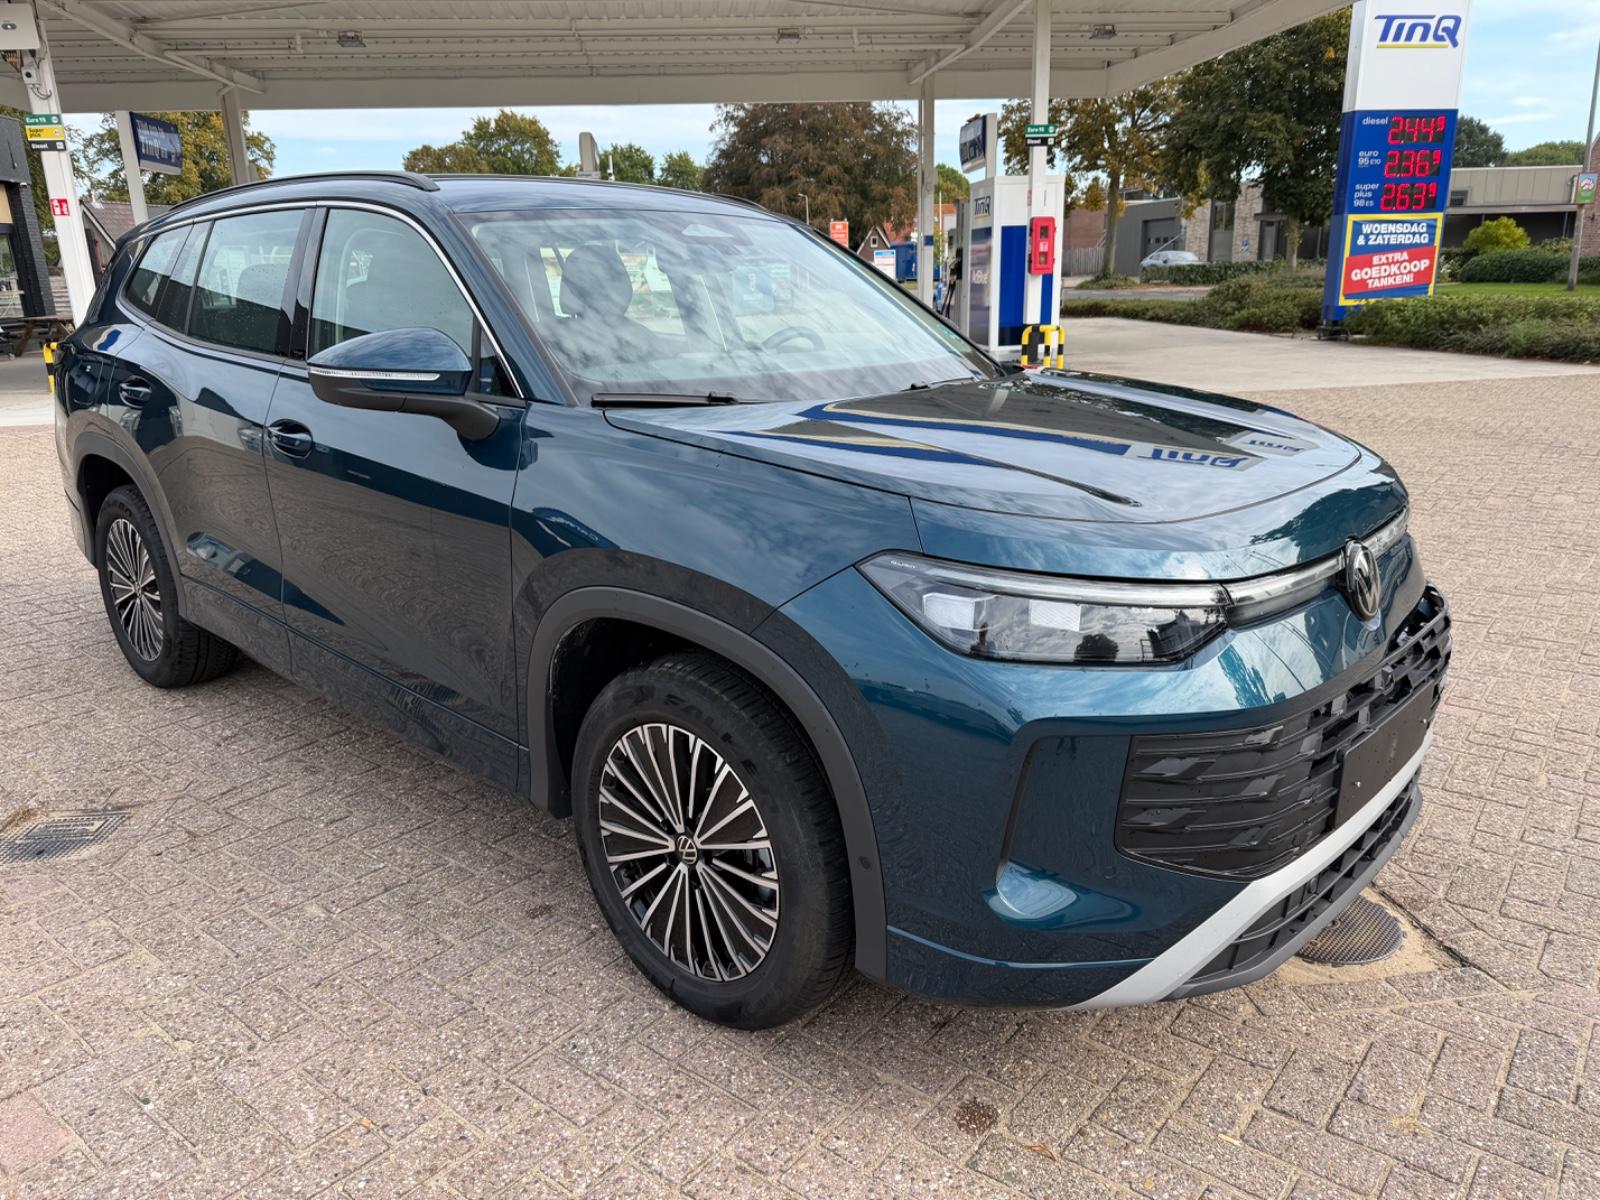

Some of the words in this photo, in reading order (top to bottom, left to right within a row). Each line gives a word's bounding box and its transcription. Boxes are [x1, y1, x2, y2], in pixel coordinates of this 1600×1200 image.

[1374, 14, 1462, 48] TinQ
[1362, 117, 1388, 125] diesel
[1358, 157, 1370, 165] 95
[1355, 183, 1380, 191] super
[1354, 190, 1373, 199] plus
[1353, 199, 1365, 207] 98
[1361, 222, 1428, 234] WOENSDAG
[1356, 235, 1366, 245] &
[1367, 233, 1430, 246] ZATERDAG
[1372, 251, 1409, 265] EXTRA
[1350, 259, 1431, 281] GOEDKOOP
[1366, 273, 1415, 289] TANKEN!
